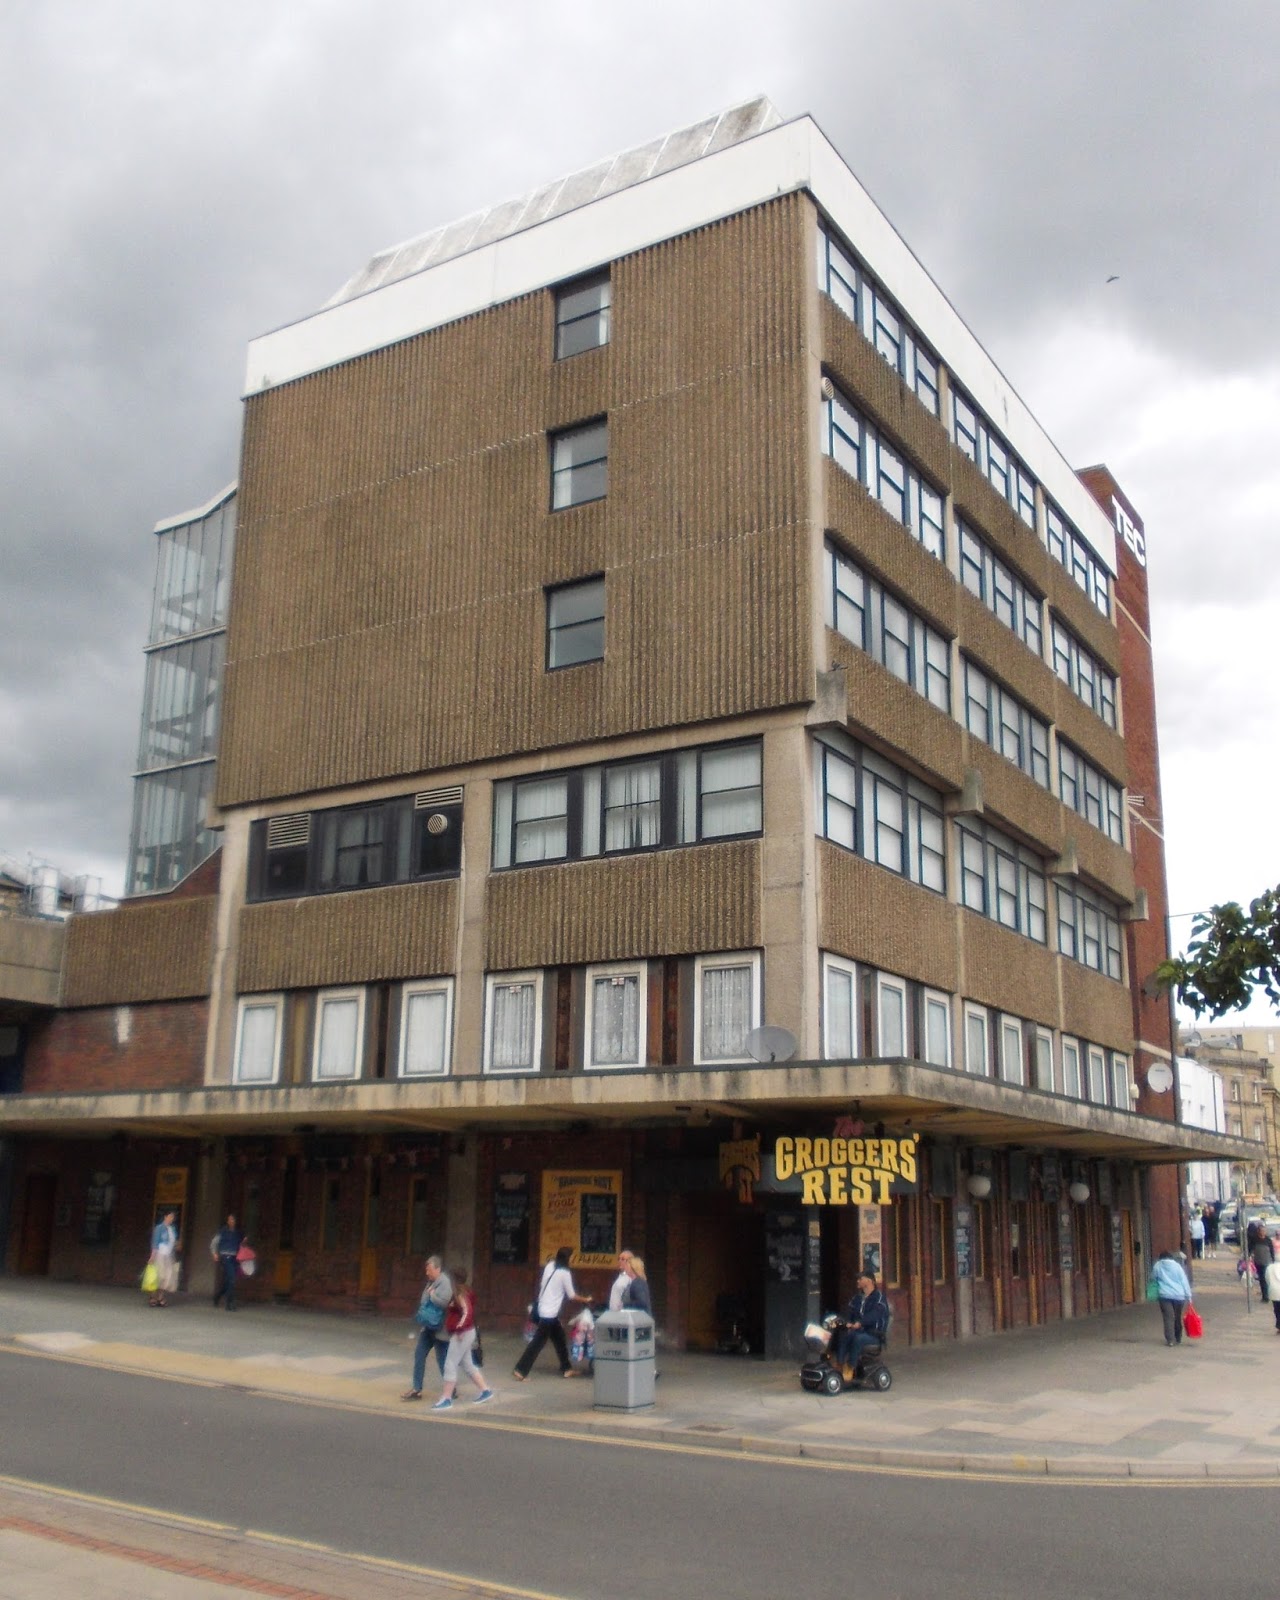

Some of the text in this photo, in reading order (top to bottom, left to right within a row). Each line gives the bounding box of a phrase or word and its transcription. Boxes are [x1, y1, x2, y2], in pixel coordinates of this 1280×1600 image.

[1112, 494, 1146, 567] TEC
[547, 1198, 575, 1209] FOOD
[801, 1167, 895, 1205] REST
